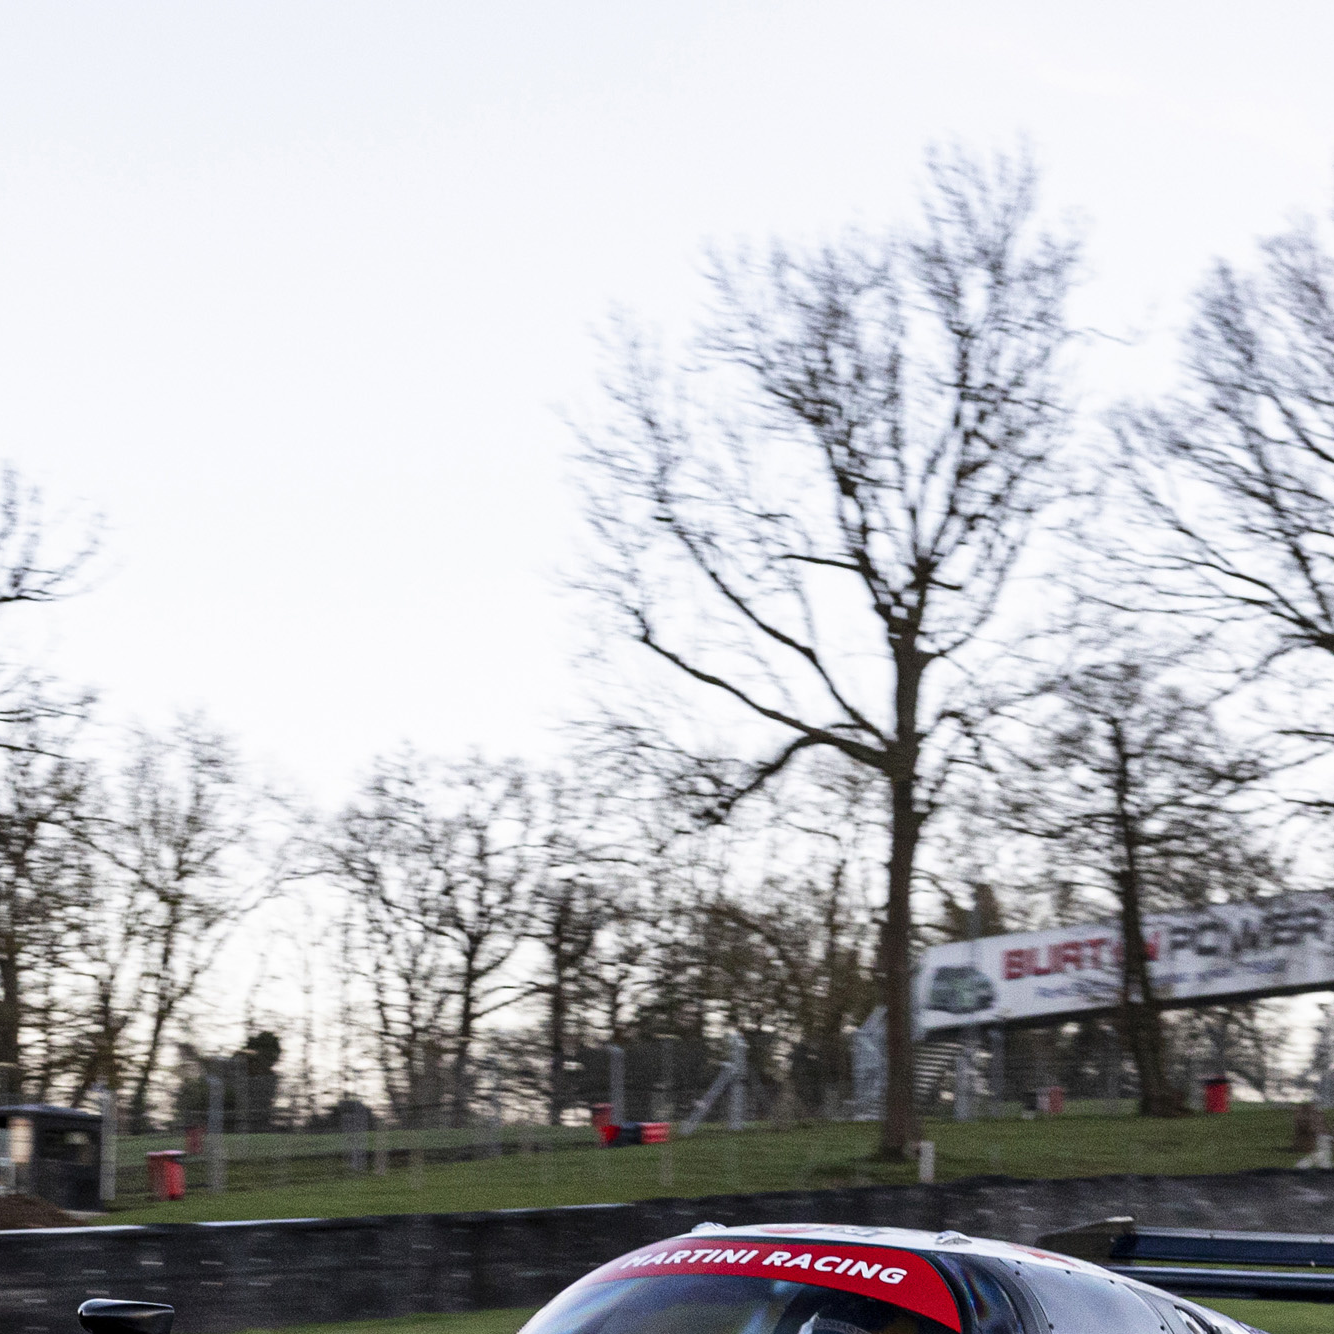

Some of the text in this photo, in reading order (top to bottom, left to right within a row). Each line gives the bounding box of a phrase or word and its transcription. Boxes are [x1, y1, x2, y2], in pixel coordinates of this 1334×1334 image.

[1001, 931, 1162, 980] BURTN
[620, 1248, 908, 1284] MARTINI RACING
